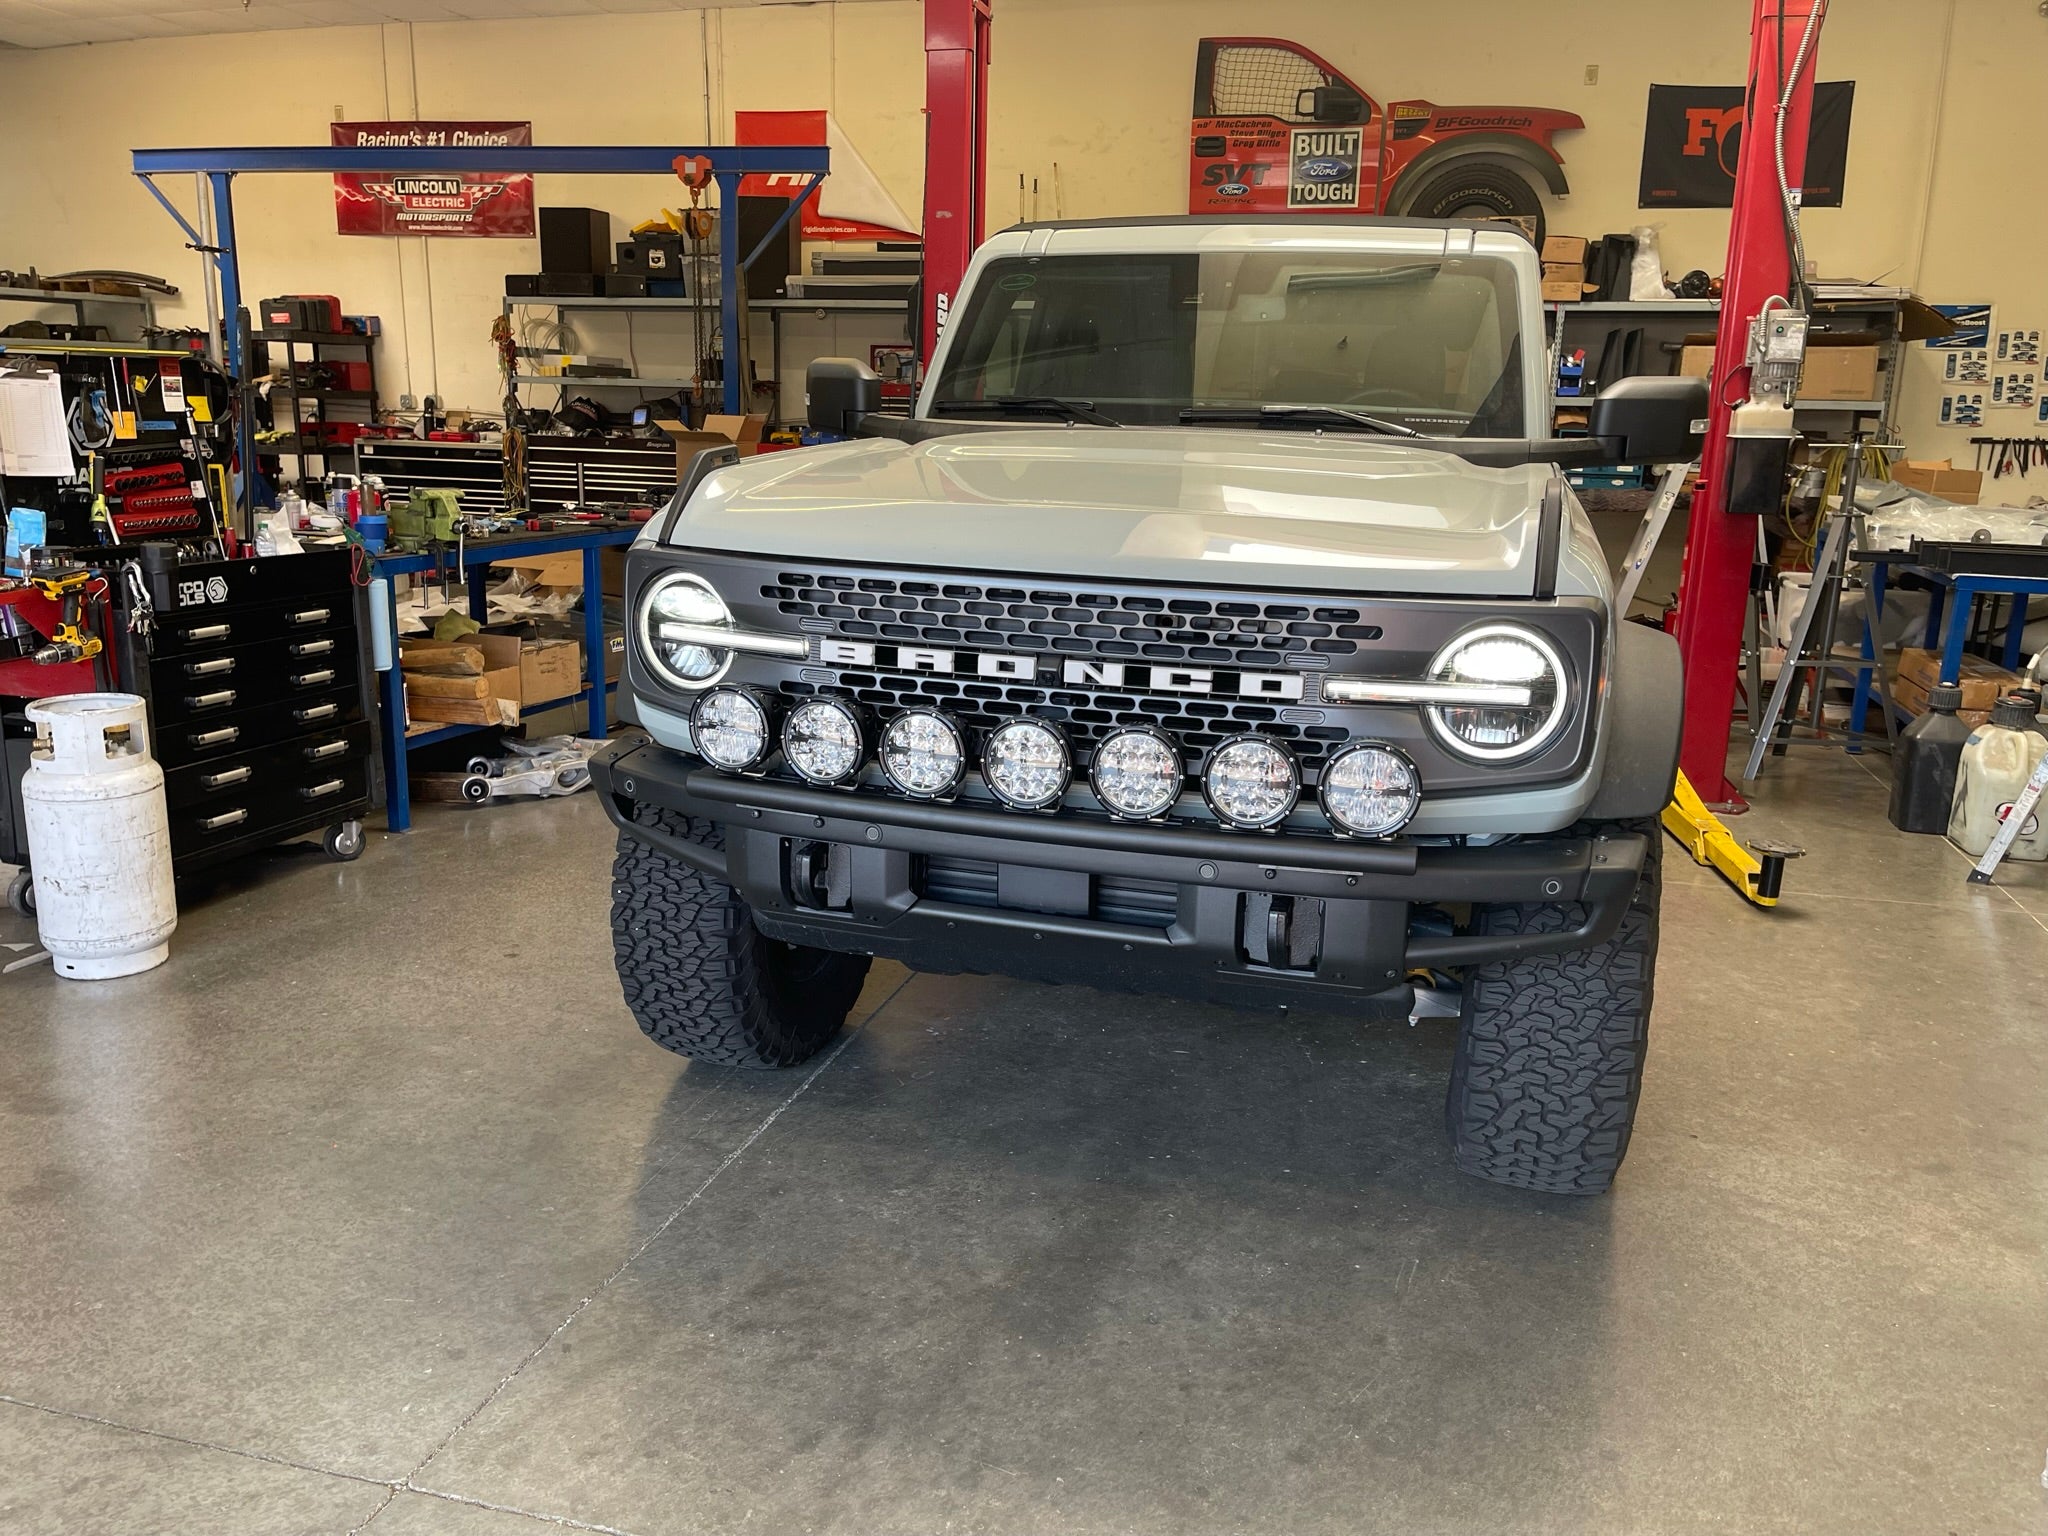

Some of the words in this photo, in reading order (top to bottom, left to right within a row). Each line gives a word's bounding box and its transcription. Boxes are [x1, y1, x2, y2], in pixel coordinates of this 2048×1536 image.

[1435, 115, 1533, 128] BFGoodrich
[357, 131, 422, 147] Racing's
[426, 131, 446, 147] #1
[452, 131, 508, 147] Choice
[1233, 140, 1255, 148] Greg
[1296, 133, 1358, 157] BUILT
[1201, 163, 1272, 186] SVT
[1310, 163, 1338, 177] Ford
[397, 181, 457, 195] LINCOLN
[1222, 185, 1244, 195] Ford
[1294, 183, 1353, 201] TOUGH
[412, 197, 465, 208] ELECTRIC
[1433, 187, 1514, 216] BFGoodrich
[396, 212, 473, 222] MOTORSPORTS
[803, 225, 857, 233] rigidindustries.com
[820, 640, 1305, 700] BRONCO
